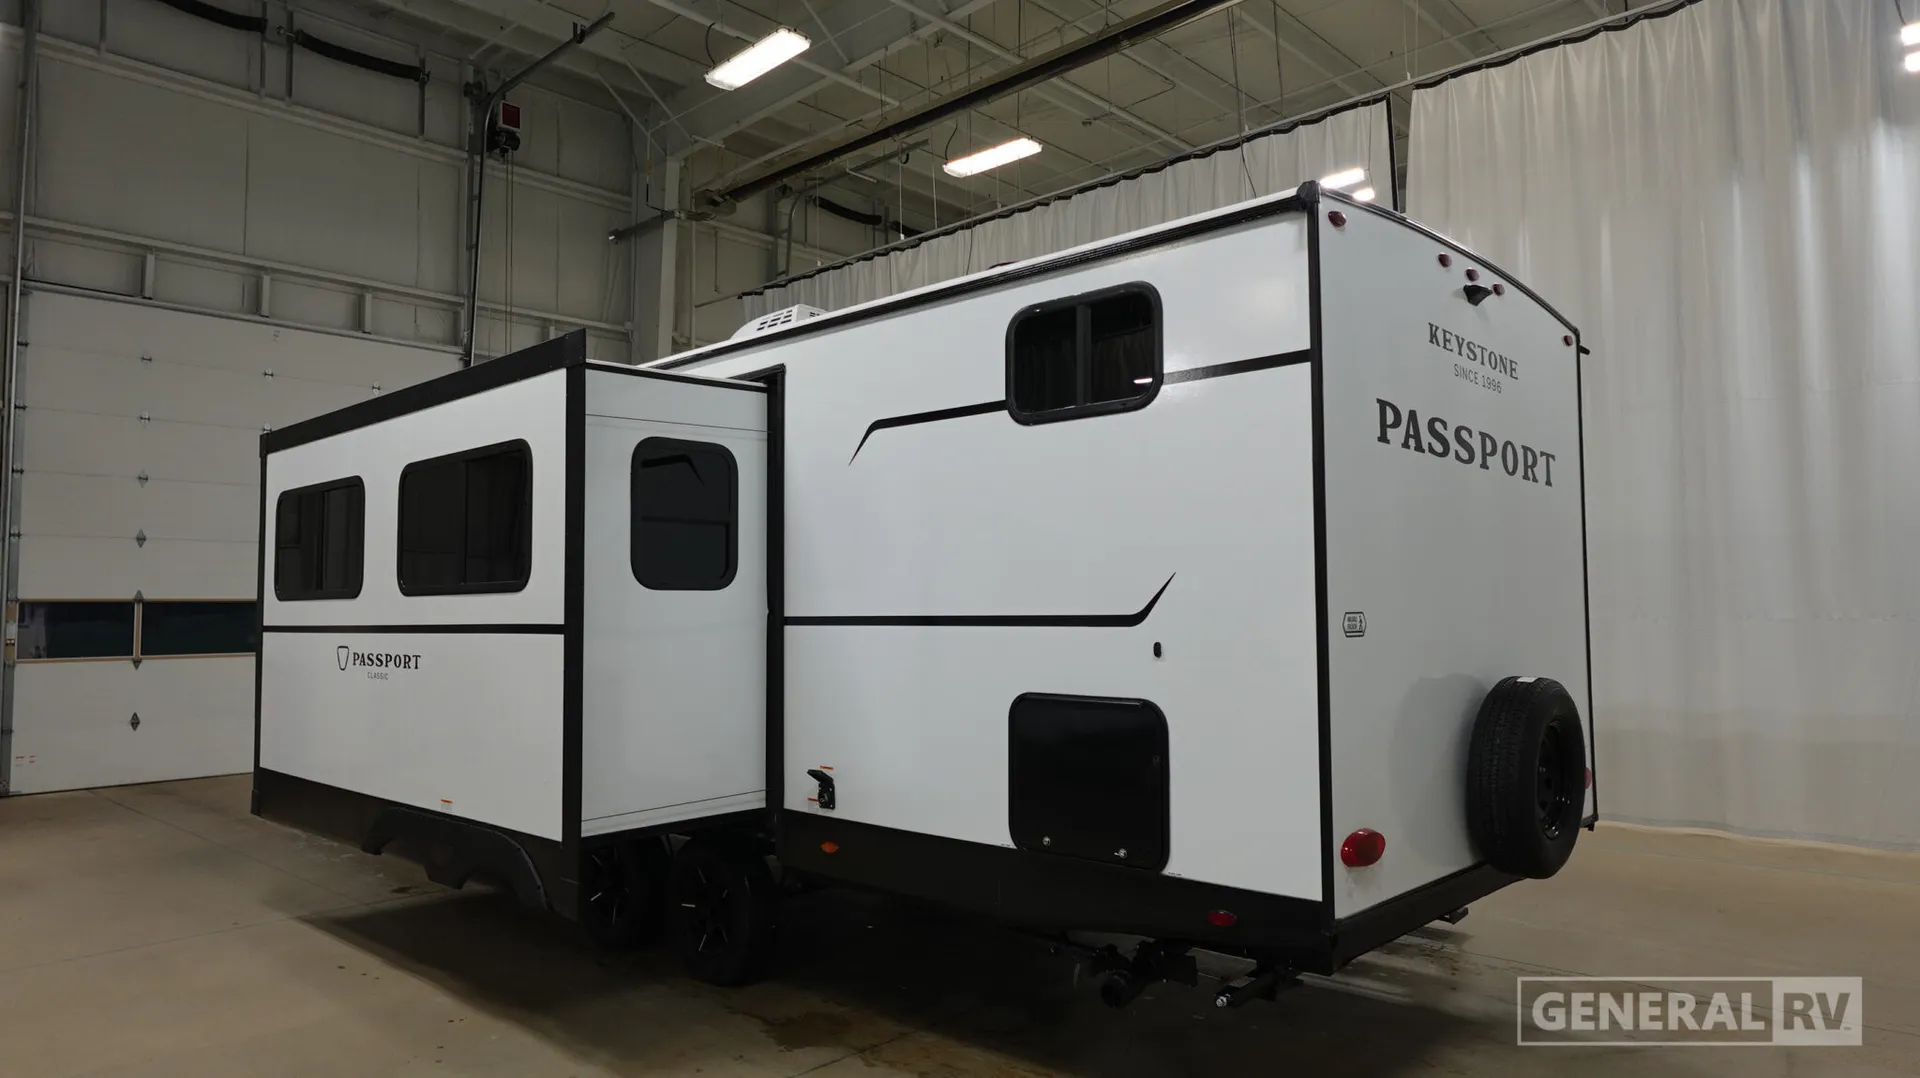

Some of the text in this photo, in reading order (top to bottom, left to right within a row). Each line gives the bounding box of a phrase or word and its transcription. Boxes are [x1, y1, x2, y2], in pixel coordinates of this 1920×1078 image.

[1428, 322, 1519, 380] KEYSTONE
[1453, 363, 1502, 394] SINCE 1996
[1376, 398, 1556, 487] PASSPORT
[352, 652, 421, 670] PASSPORT
[367, 671, 389, 681] CLASSIC
